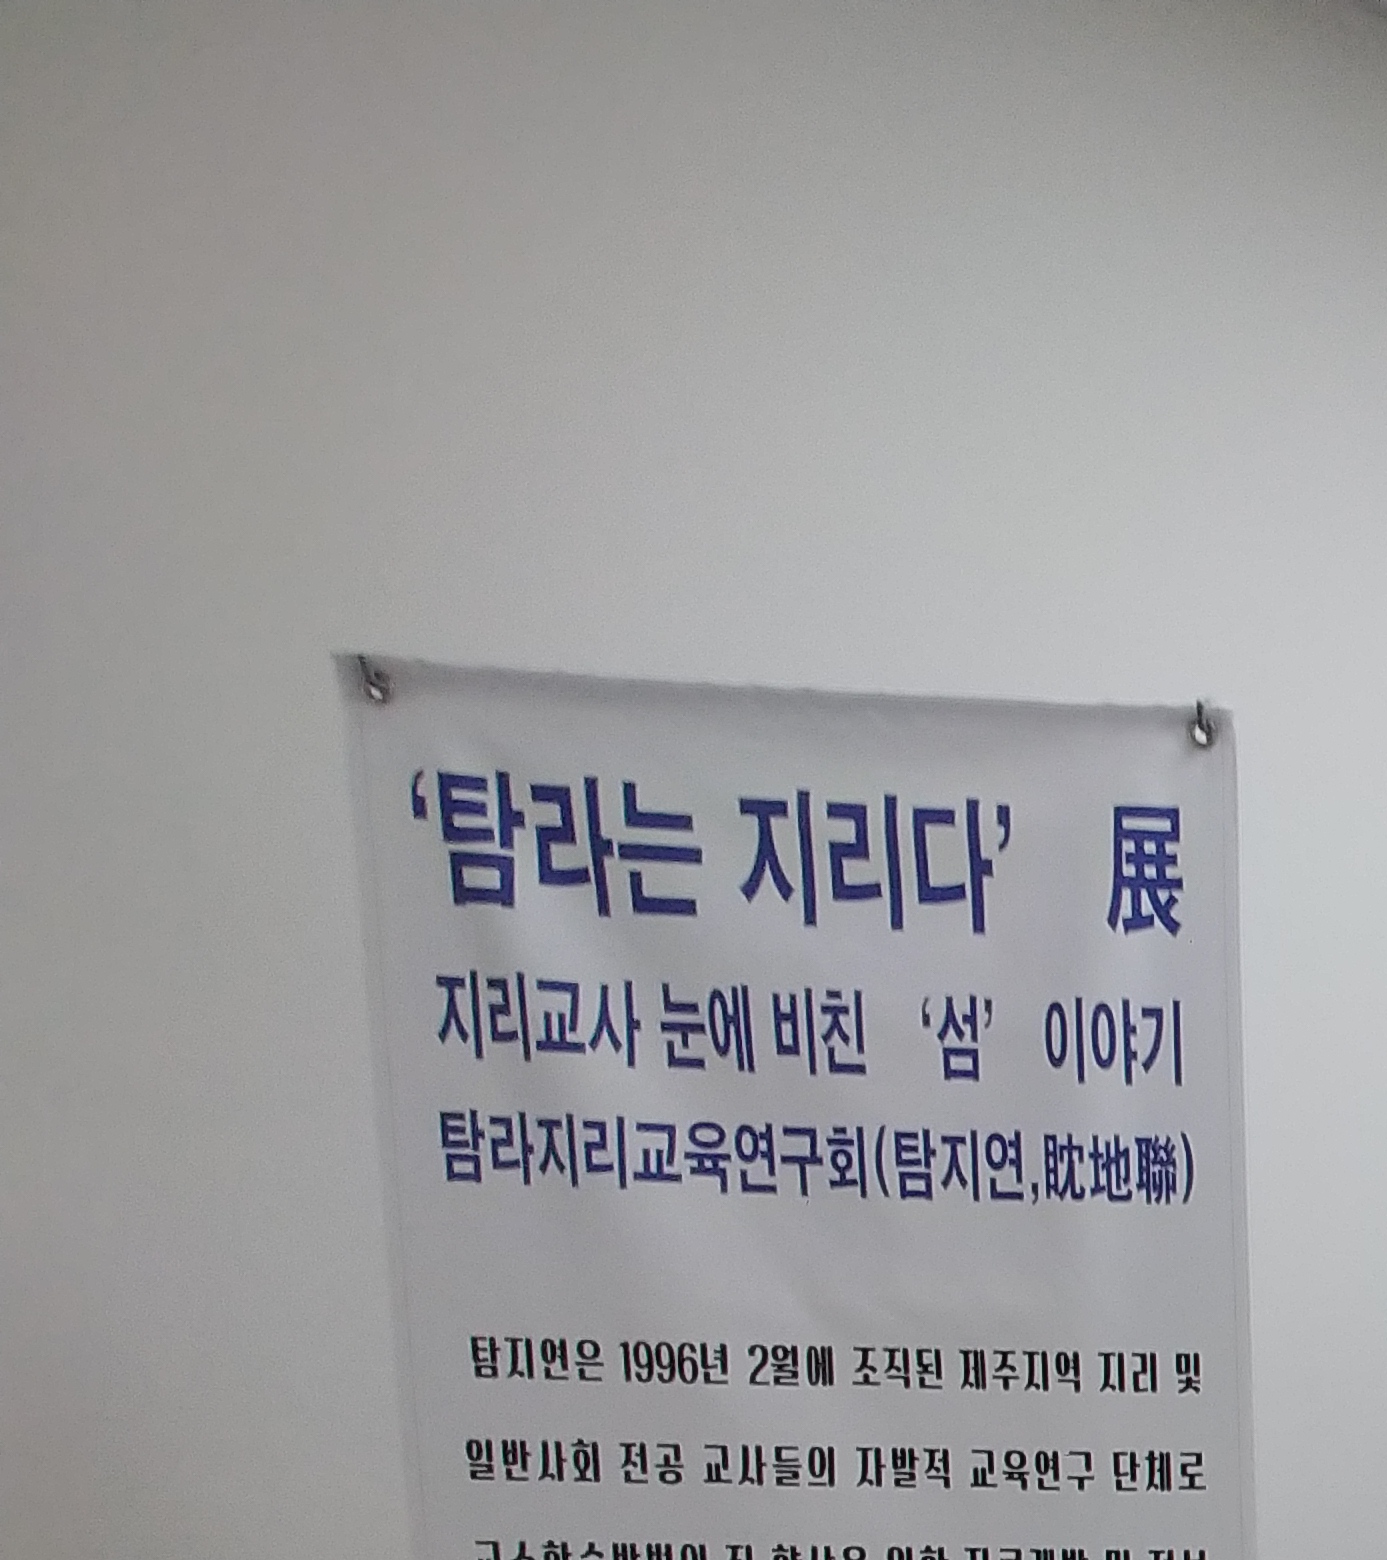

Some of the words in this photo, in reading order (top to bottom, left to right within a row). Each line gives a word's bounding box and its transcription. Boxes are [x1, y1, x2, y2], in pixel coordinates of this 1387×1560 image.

[1106, 805, 1184, 938] 展
[435, 968, 642, 1069] 지리교사
[660, 982, 756, 1074] 눈에
[772, 987, 867, 1076] 비친
[1044, 996, 1183, 1087] 이야기
[470, 1335, 605, 1382] 탐지연은
[619, 1340, 729, 1385] 1996년
[747, 1344, 835, 1387] 2월에
[852, 1346, 943, 1390] 조직된
[958, 1349, 1081, 1394] 제주지역
[1097, 1351, 1158, 1394] 지리
[1175, 1352, 1201, 1394] 및
[465, 1438, 601, 1483] 일반사회
[619, 1441, 684, 1485] 전공
[703, 1444, 836, 1488] 교사들의
[855, 1446, 951, 1489] 자발적
[970, 1449, 1095, 1492] 교육연구
[1112, 1449, 1207, 1492] 단체로
